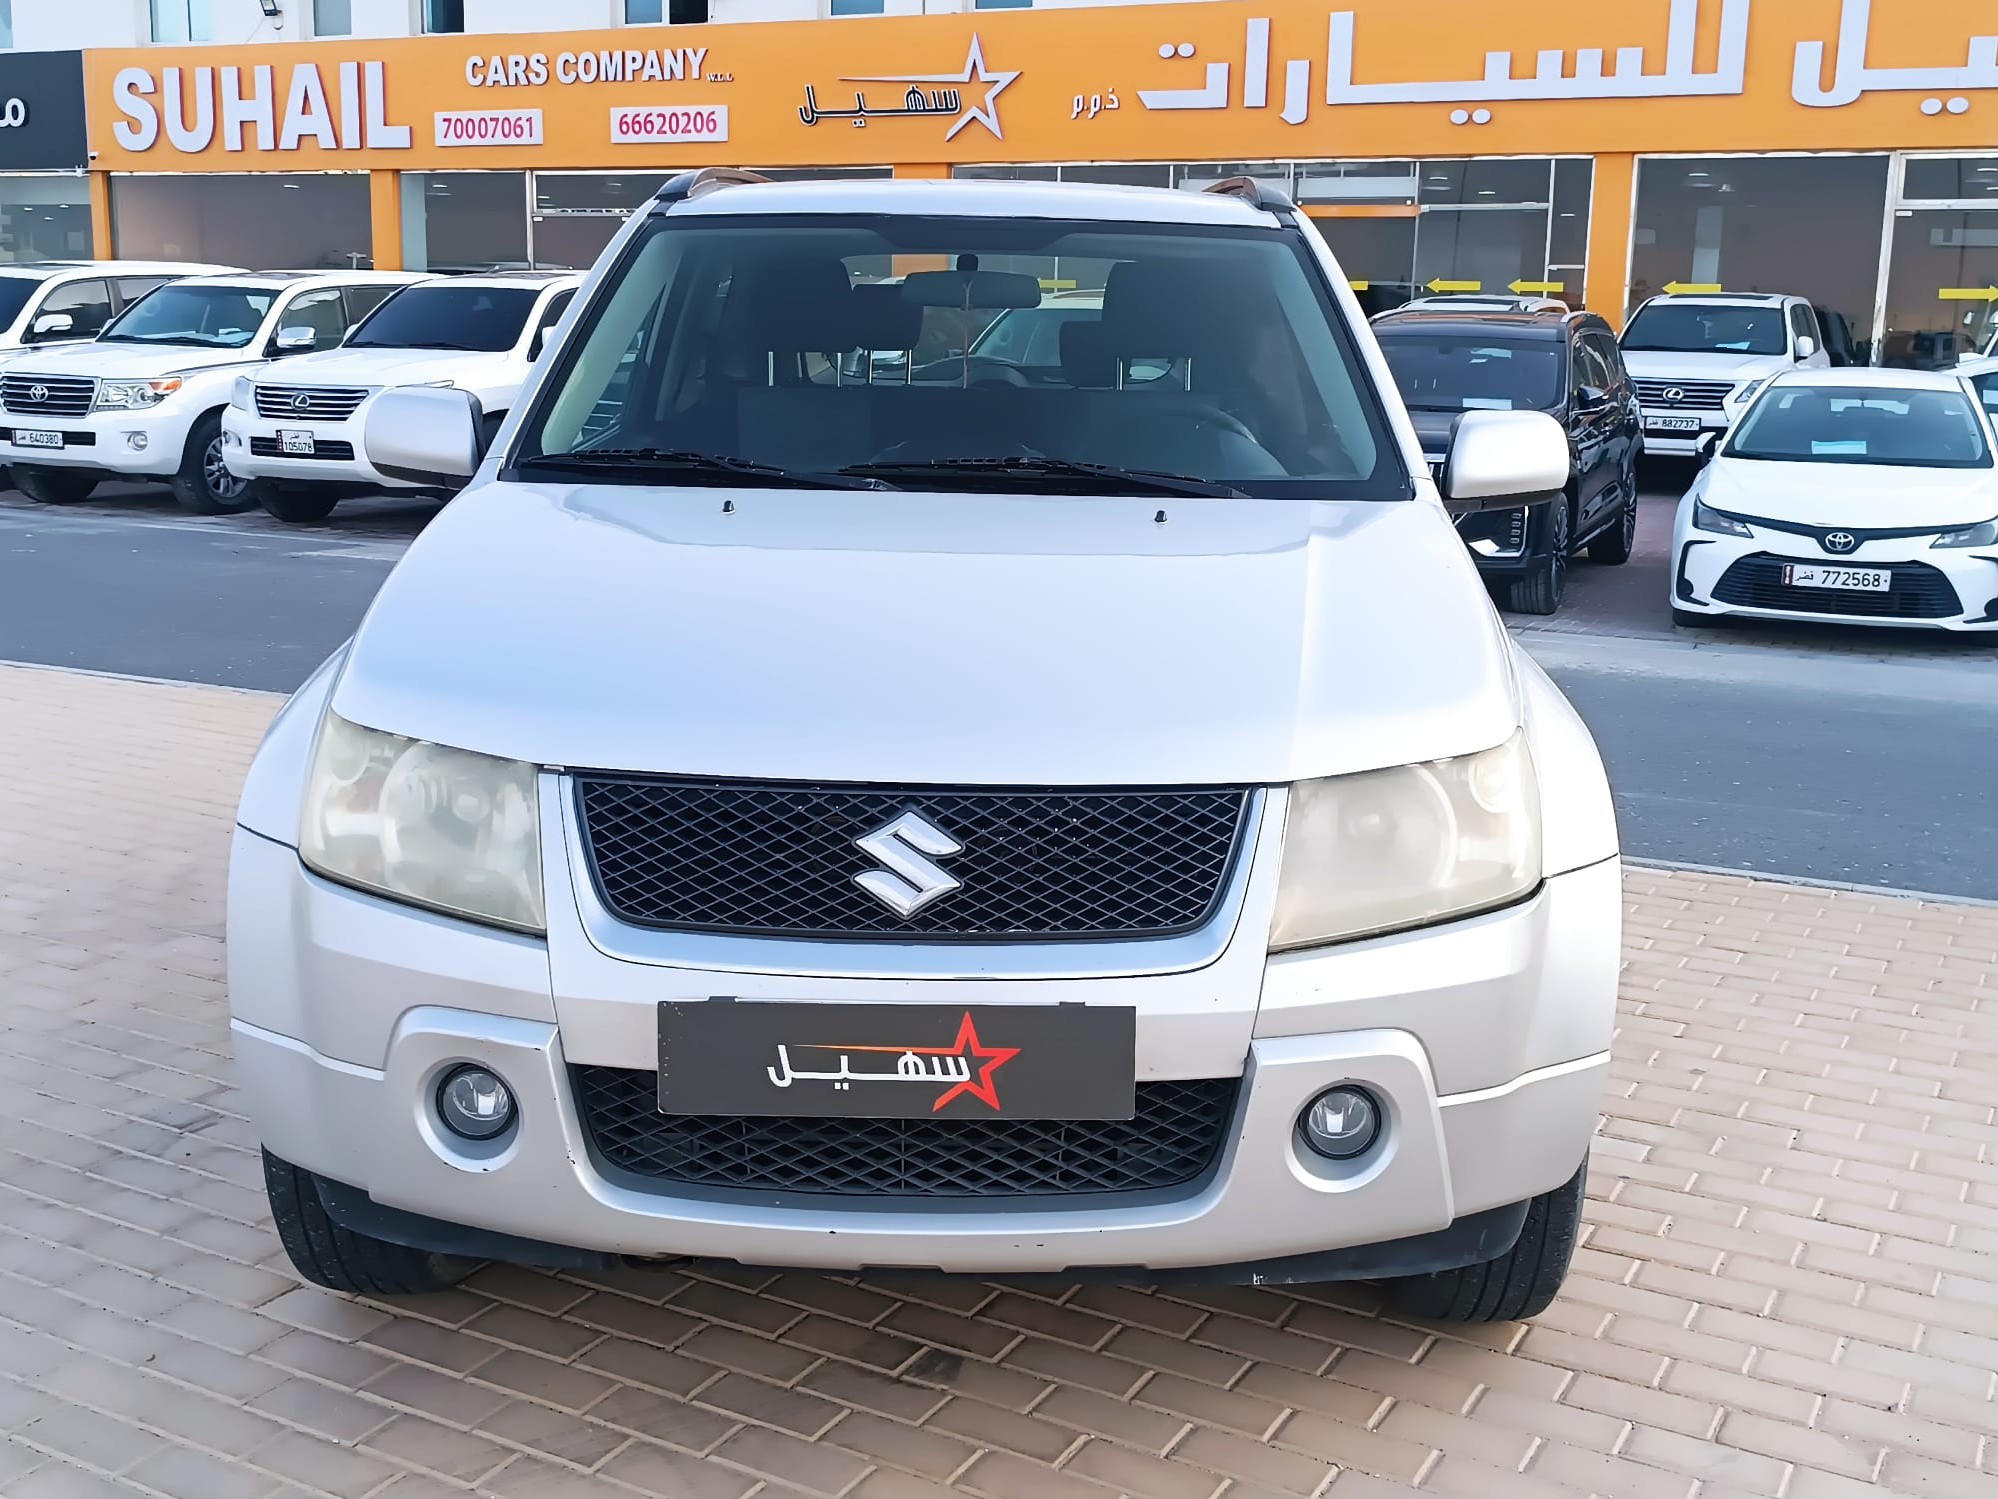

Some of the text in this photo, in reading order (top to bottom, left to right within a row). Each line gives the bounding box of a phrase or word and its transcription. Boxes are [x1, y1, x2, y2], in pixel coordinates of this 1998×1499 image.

[465, 53, 548, 87] CARS
[556, 47, 708, 84] COMPANY
[1136, 0, 1750, 125] للسيارات
[112, 61, 412, 152] SUHAIL
[798, 84, 962, 127] سهيل
[442, 116, 534, 140] 70007061
[619, 111, 717, 135] 66620206
[29, 432, 59, 445] 640380
[1662, 418, 1695, 429] 882737
[1821, 570, 1881, 588] 772568
[766, 1044, 971, 1090] سهيل
